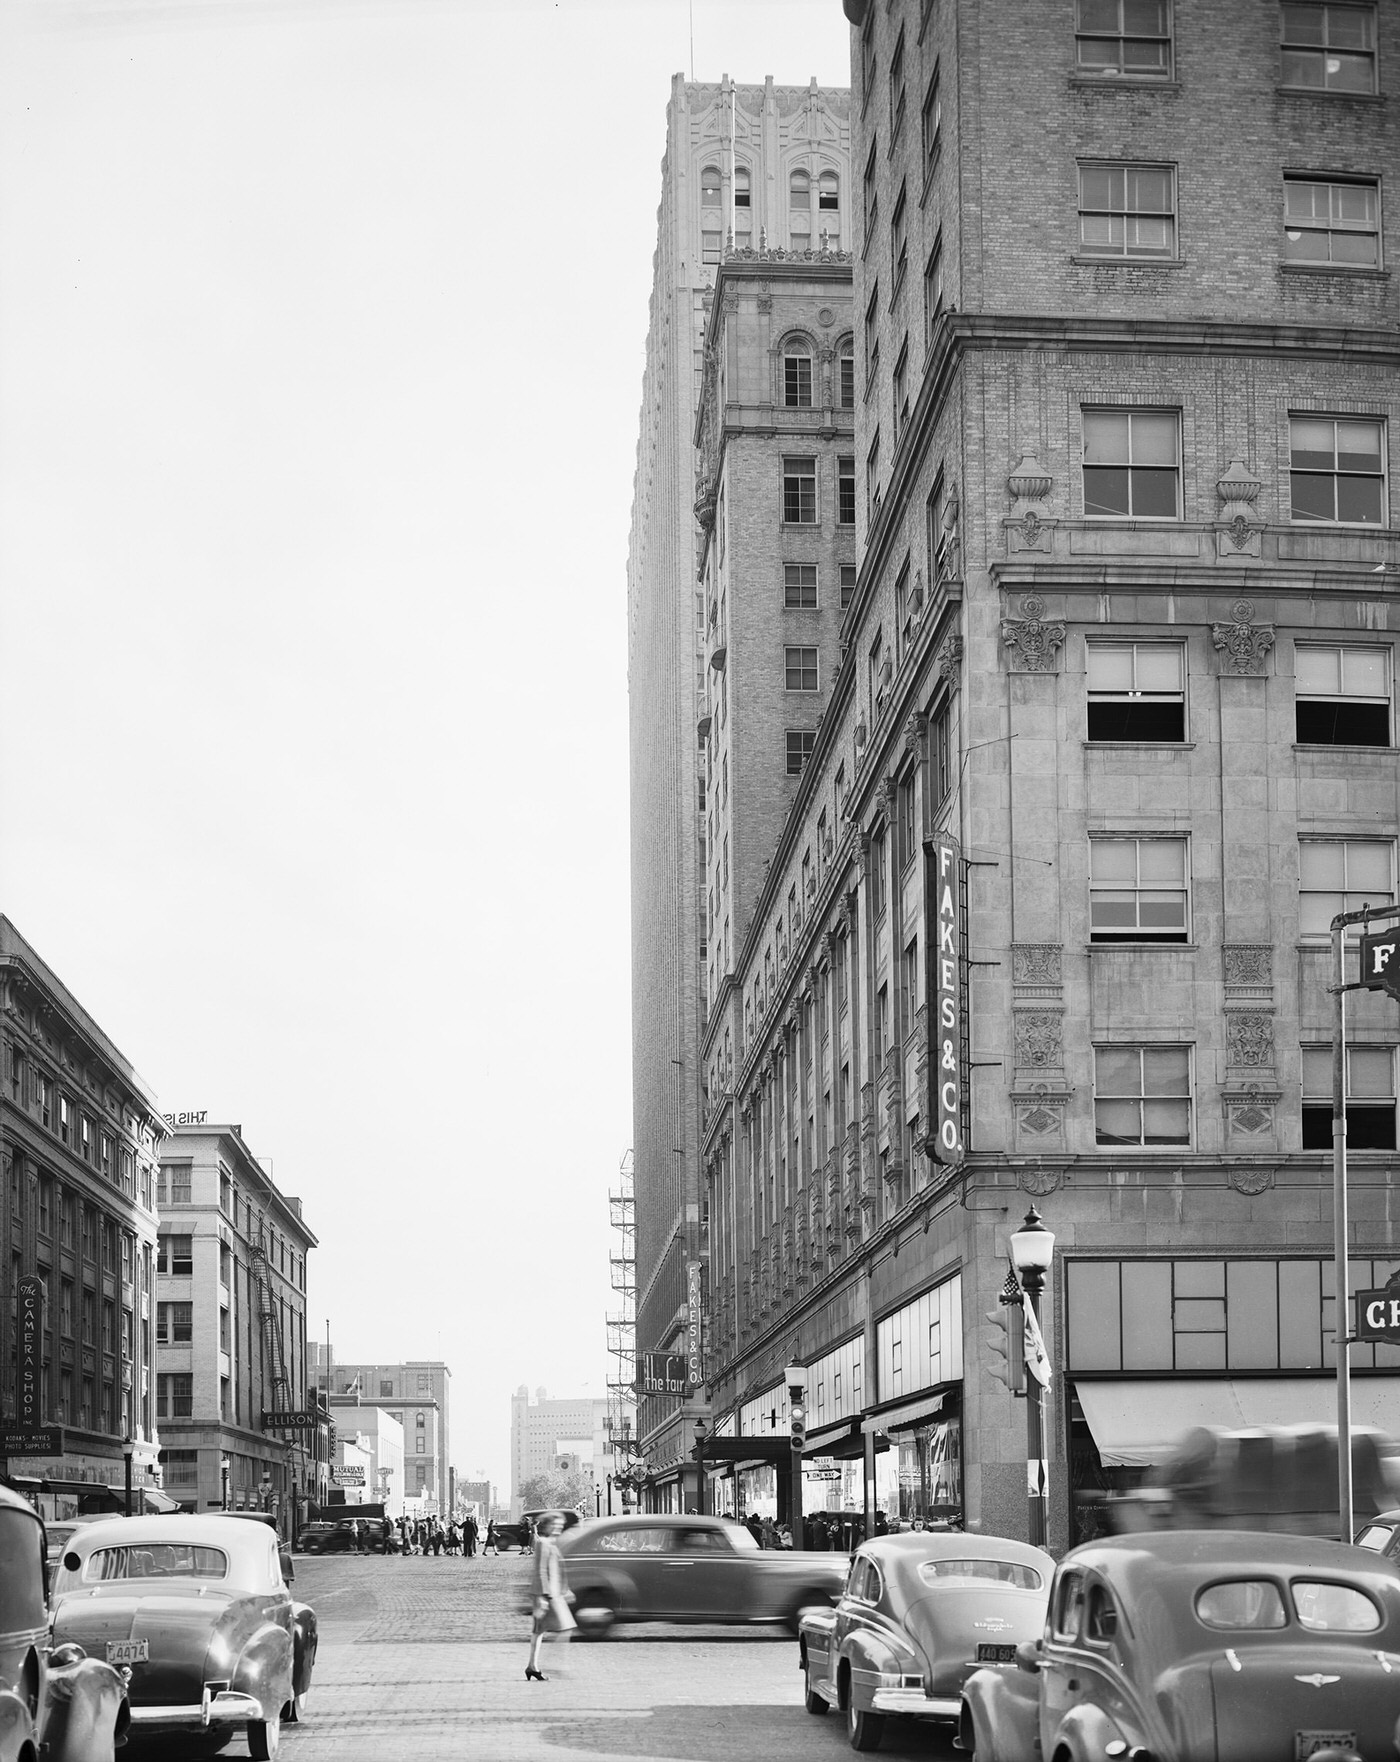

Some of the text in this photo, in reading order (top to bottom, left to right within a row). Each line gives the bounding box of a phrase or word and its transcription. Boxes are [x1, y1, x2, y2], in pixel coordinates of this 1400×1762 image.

[941, 846, 955, 1029] FAKES
[942, 1039, 956, 1072] &
[20, 1283, 37, 1297] The
[689, 1266, 698, 1337] FAKES
[24, 1298, 35, 1366] CAMERA
[689, 1341, 698, 1353] &
[645, 1354, 685, 1392] the fair
[23, 1371, 34, 1416] SHOP
[267, 1415, 313, 1426] ELLISON
[116, 1644, 145, 1660] 4474
